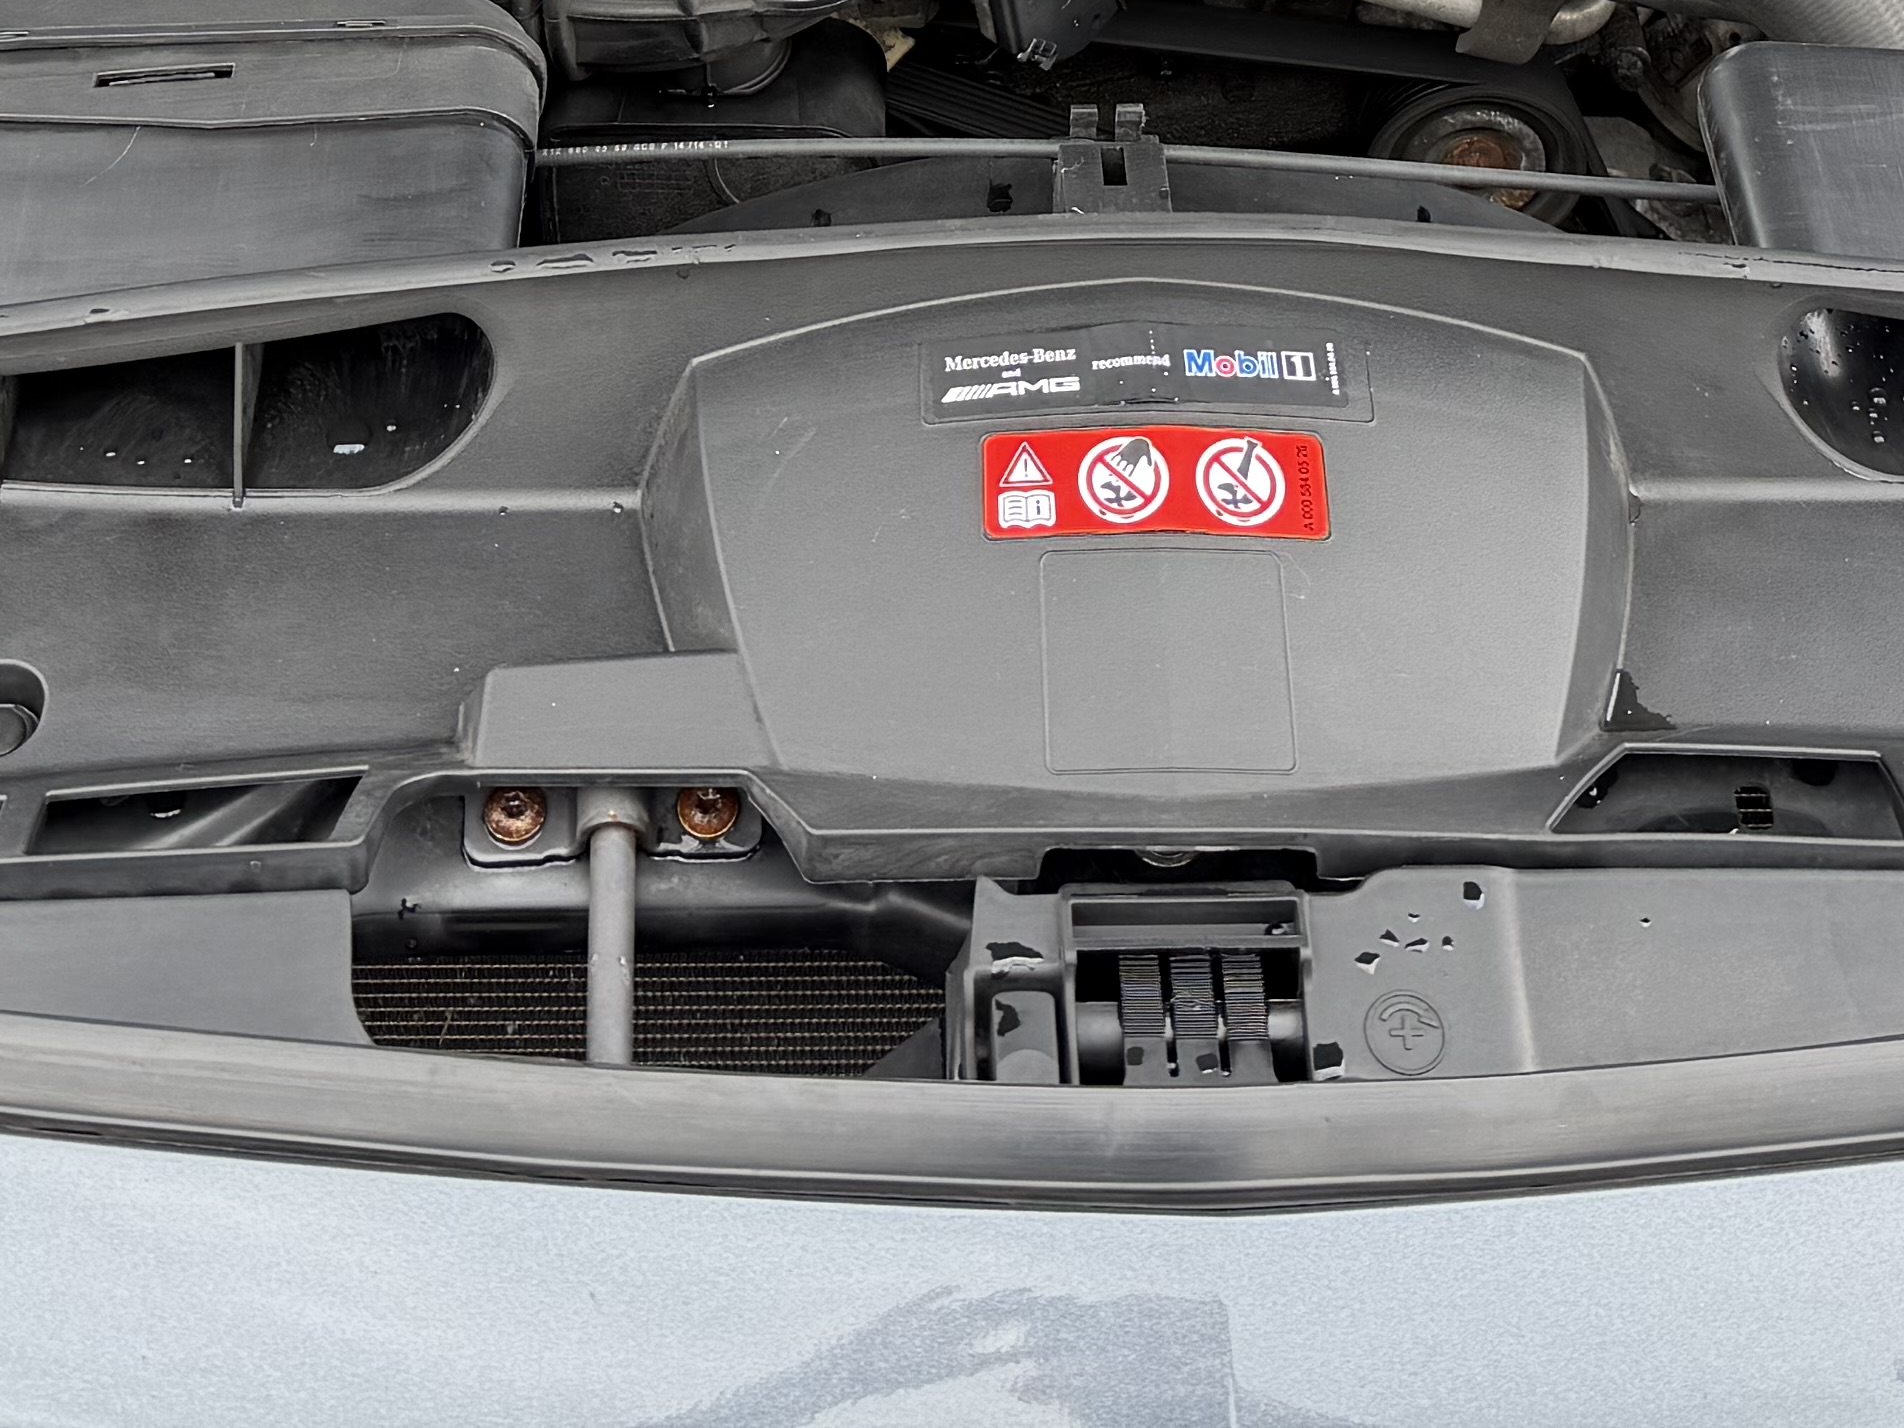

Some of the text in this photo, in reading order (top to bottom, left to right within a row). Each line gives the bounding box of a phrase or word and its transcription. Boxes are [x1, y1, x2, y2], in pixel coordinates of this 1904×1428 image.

[944, 347, 1077, 373] Mercedes-Benz
[1091, 354, 1171, 370] recommend
[1184, 349, 1279, 379] Mobil
